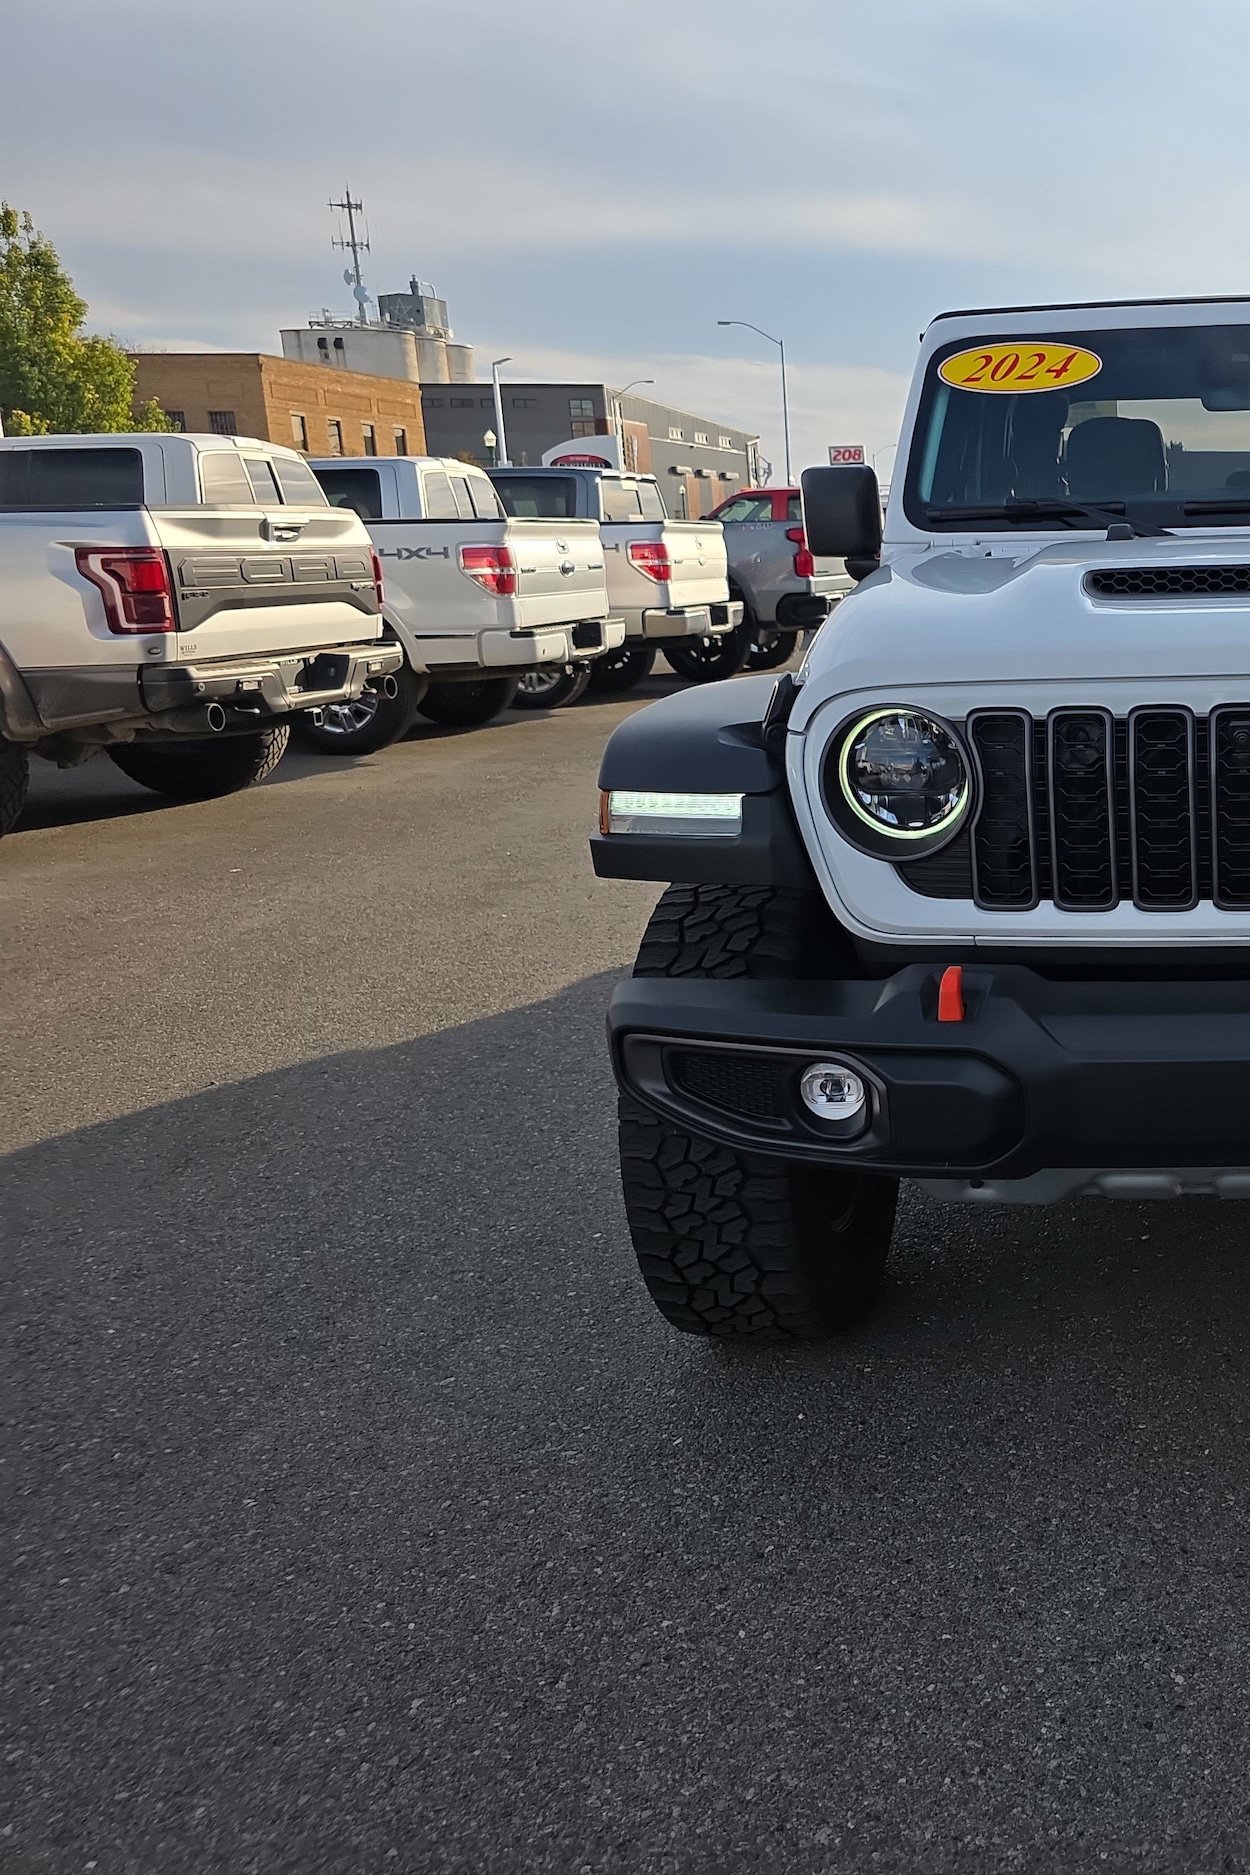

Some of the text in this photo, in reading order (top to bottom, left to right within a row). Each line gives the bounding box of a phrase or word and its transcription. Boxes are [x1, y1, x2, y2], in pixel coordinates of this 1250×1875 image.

[961, 351, 1080, 384] 2024
[832, 448, 862, 461] 208
[379, 546, 450, 560] 4X4
[177, 555, 372, 587] FORD
